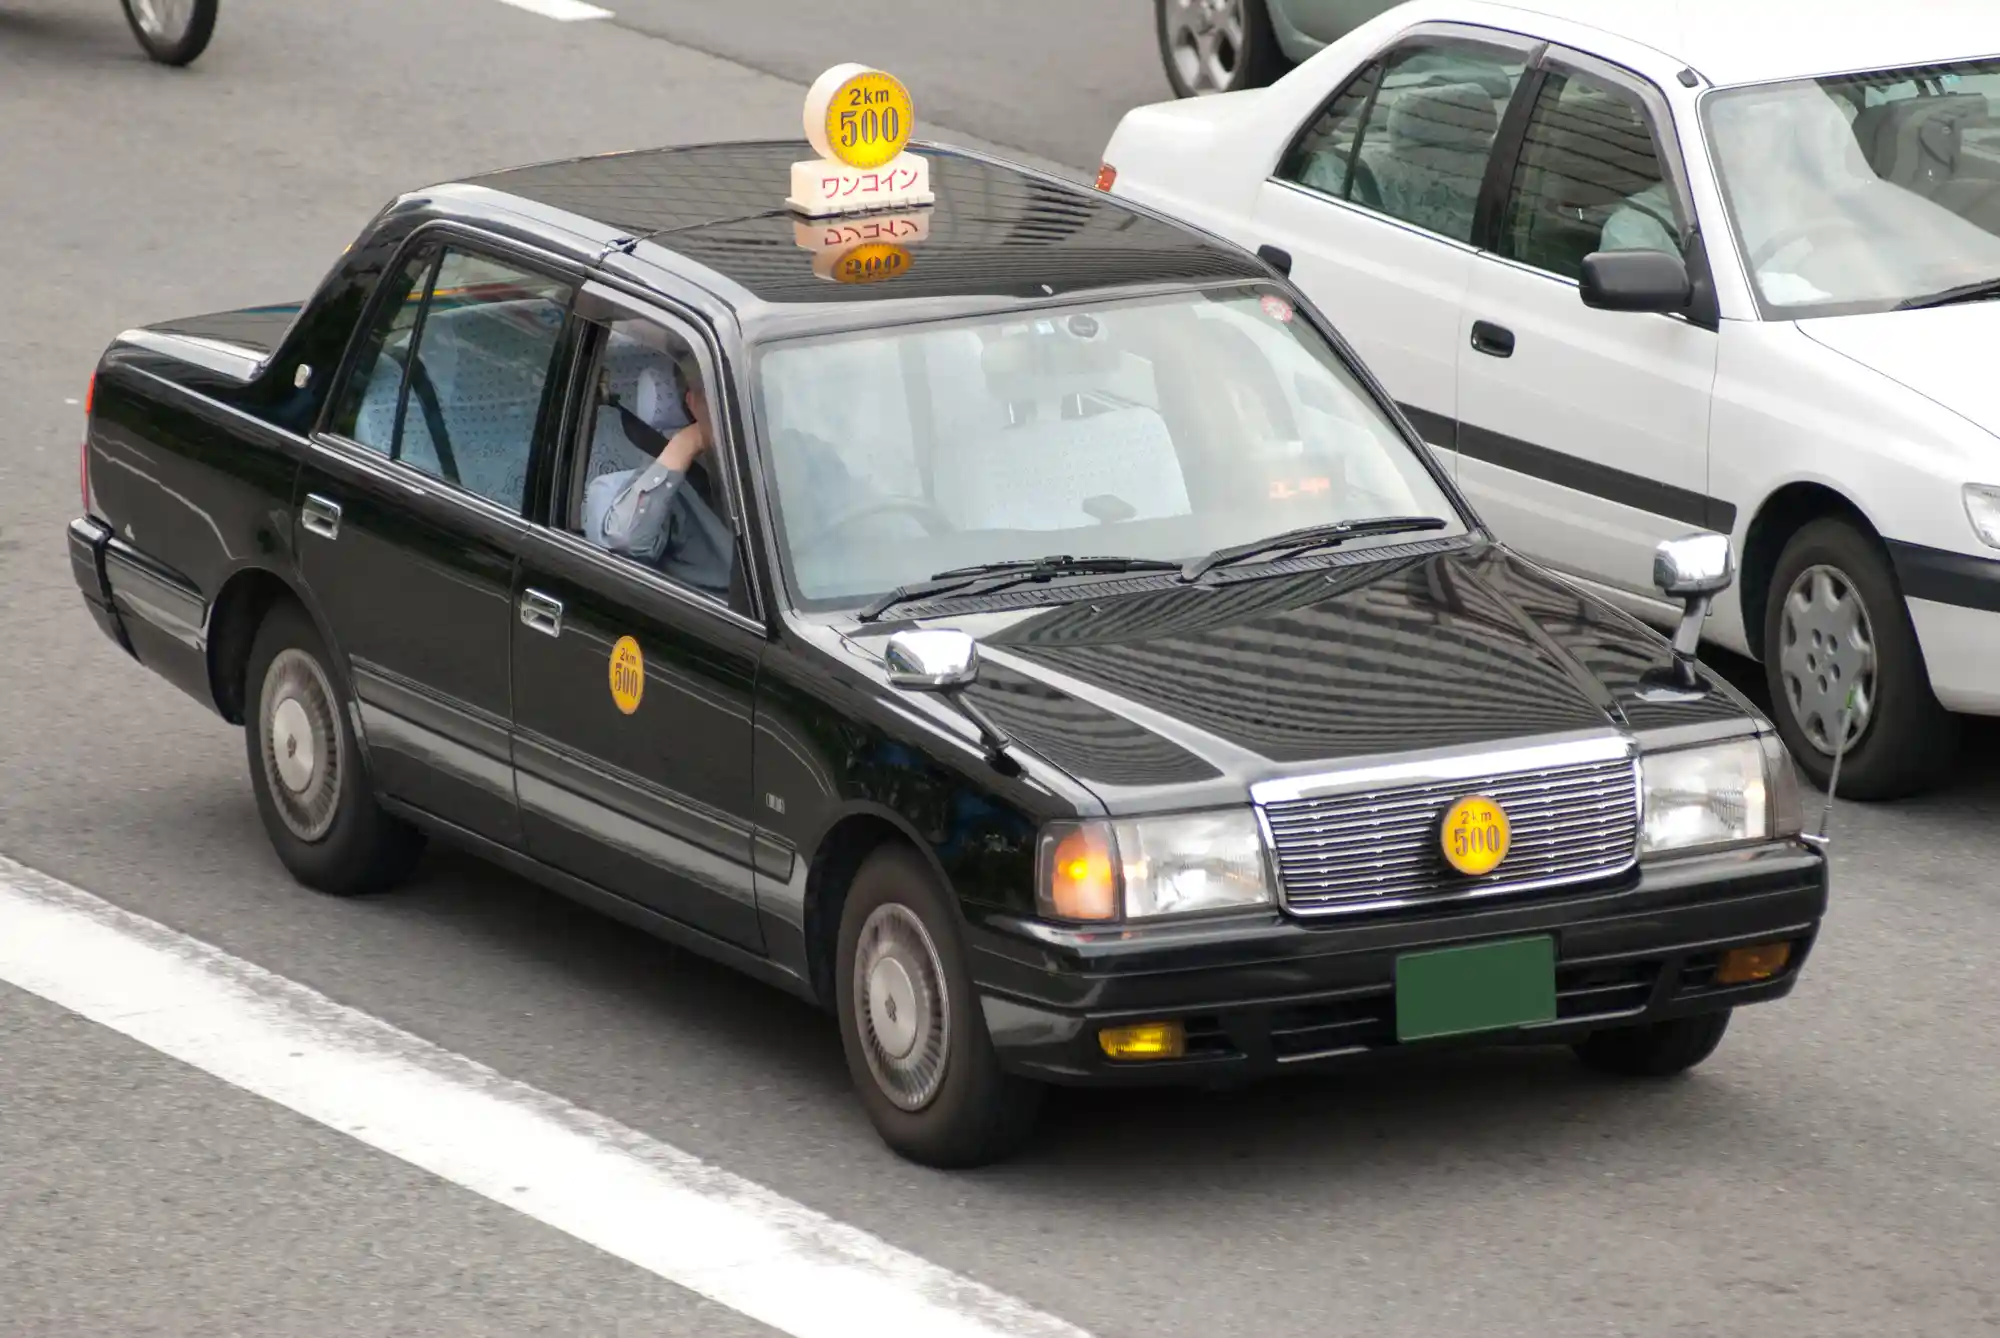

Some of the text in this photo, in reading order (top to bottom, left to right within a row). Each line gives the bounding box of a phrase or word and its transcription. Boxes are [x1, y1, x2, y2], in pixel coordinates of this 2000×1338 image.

[849, 87, 889, 106] 2km
[840, 106, 899, 147] 500
[821, 169, 918, 198] ワンコイン
[620, 647, 637, 665] 2km
[614, 662, 638, 698] 500
[1454, 825, 1500, 857] 500
